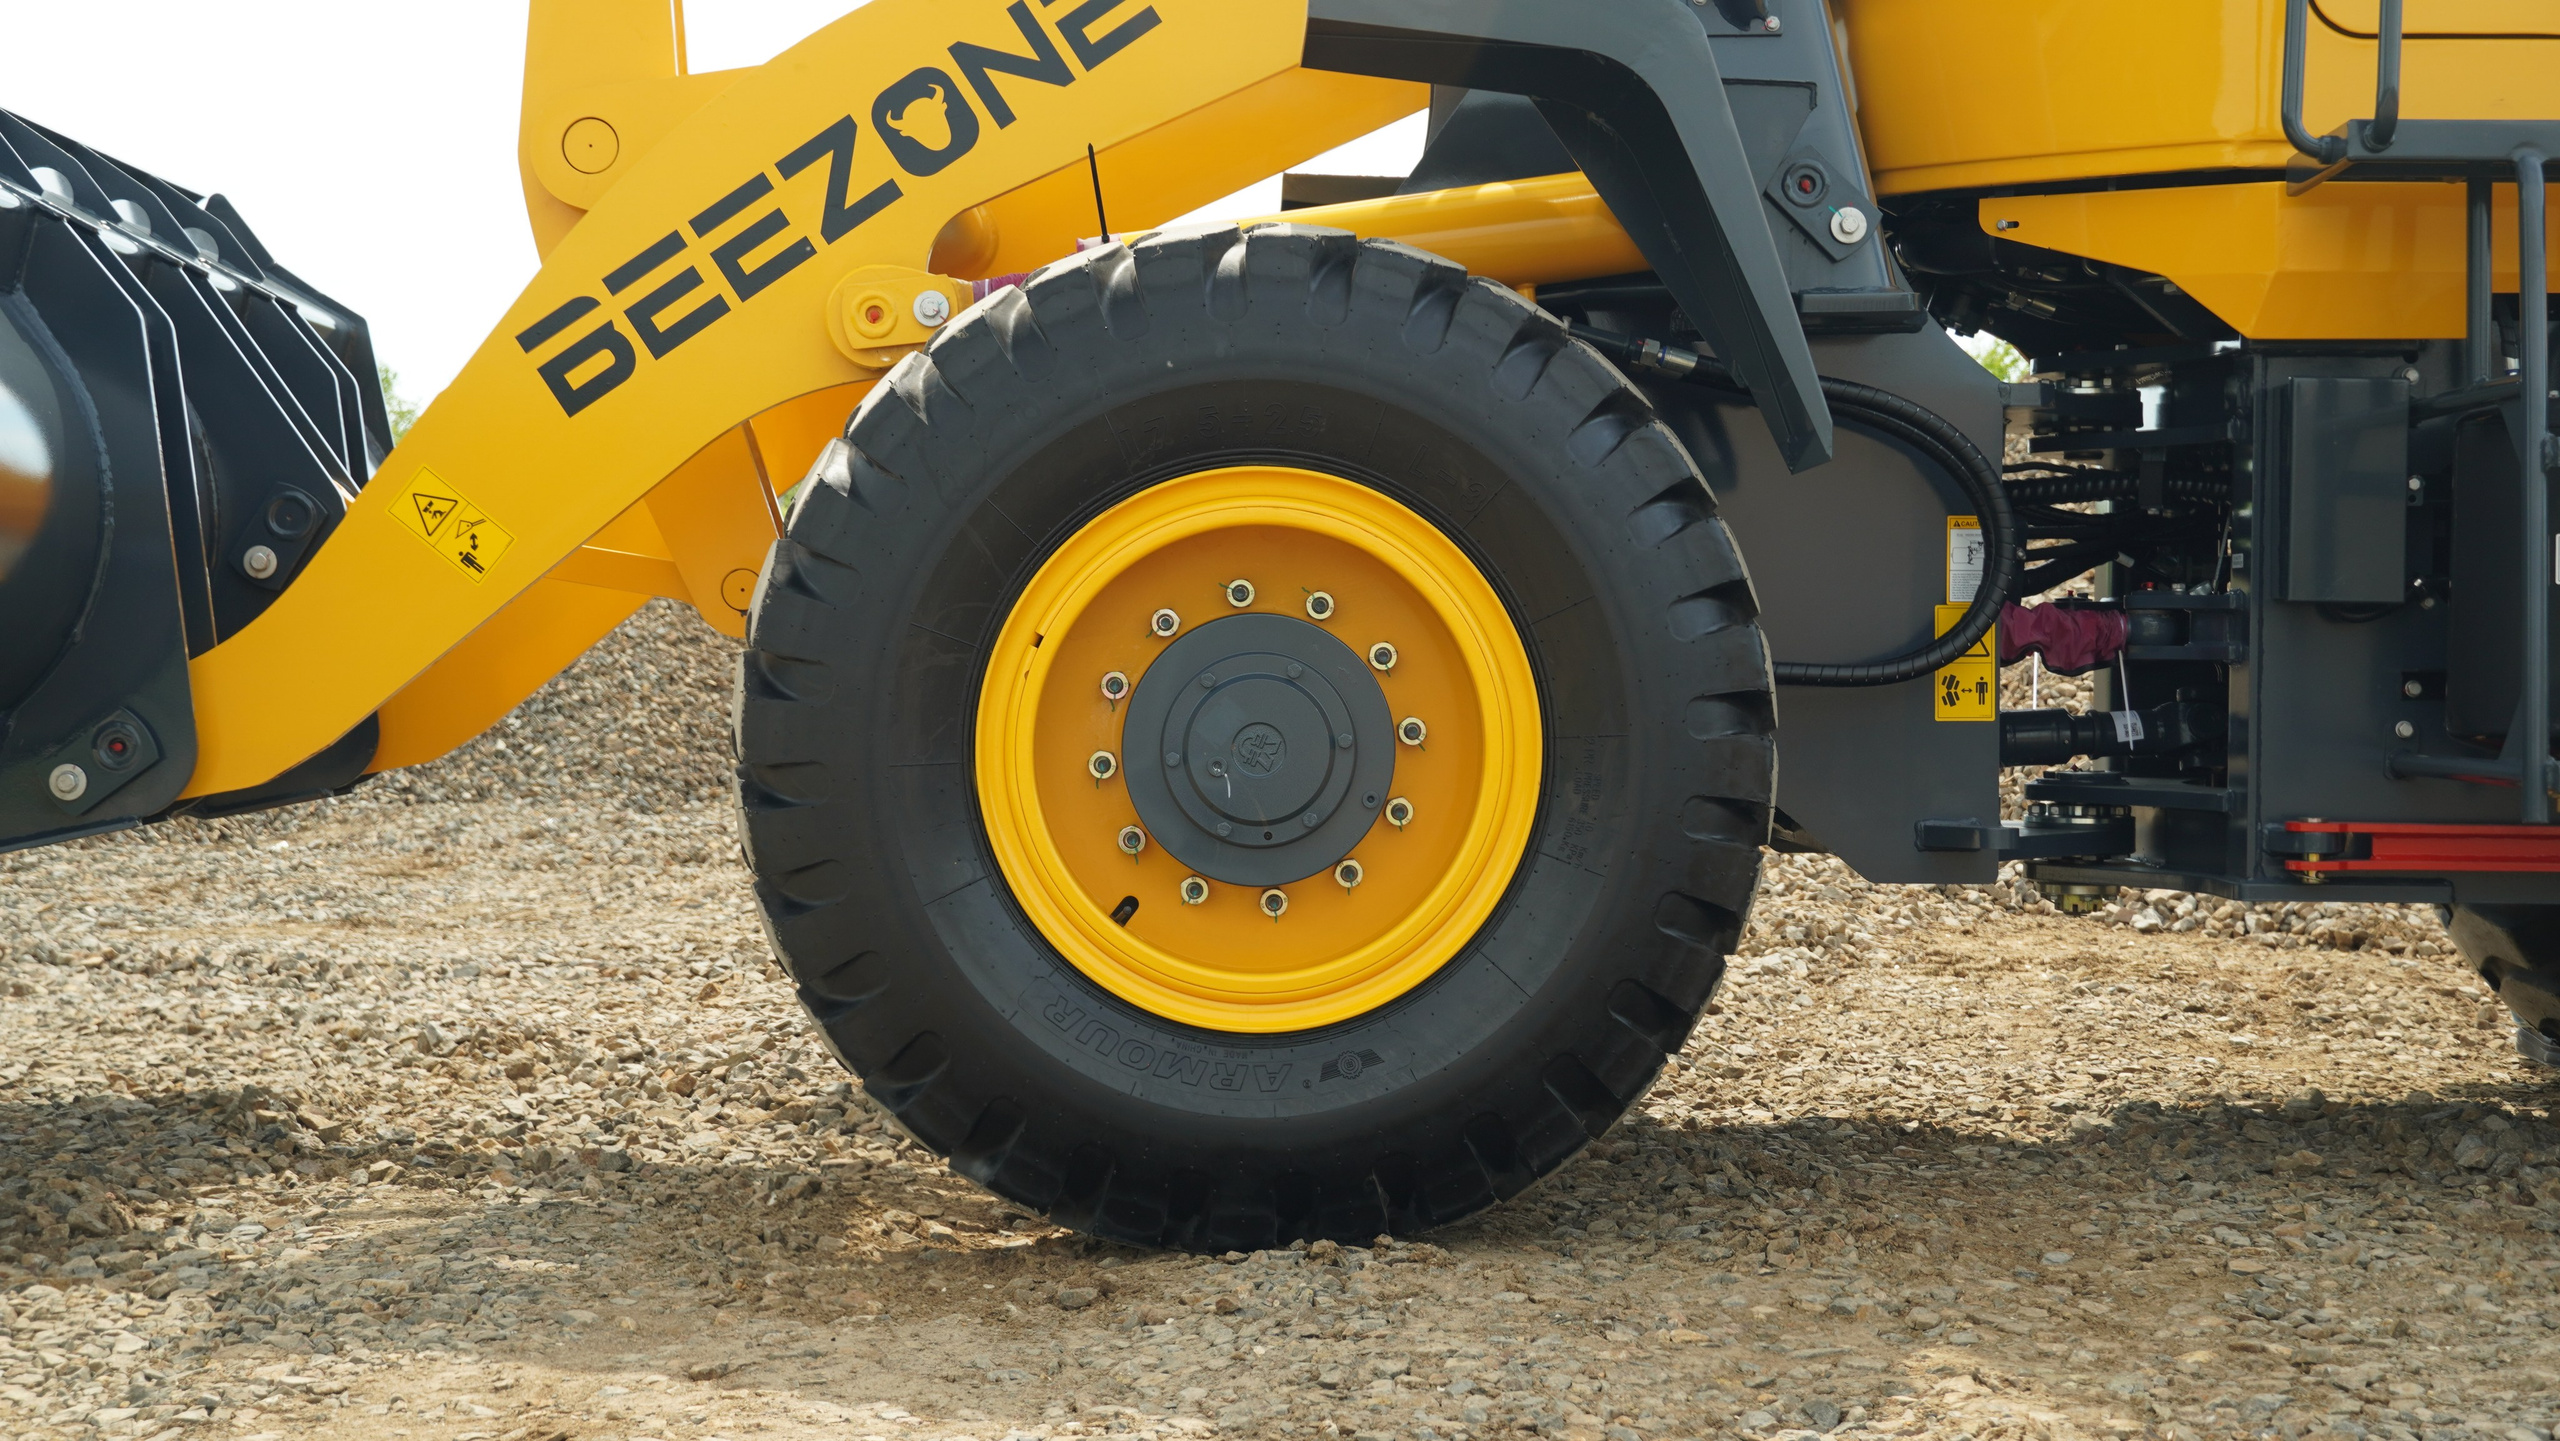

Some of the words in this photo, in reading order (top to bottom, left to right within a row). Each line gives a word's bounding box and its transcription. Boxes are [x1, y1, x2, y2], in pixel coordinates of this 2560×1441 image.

[515, 0, 1162, 418] BEEZONE
[1961, 520, 1981, 528] CAUT
[1042, 994, 1293, 1093] ARMOUR
[1176, 1041, 1203, 1054] CHINA
[1223, 1049, 1248, 1059] MADE
